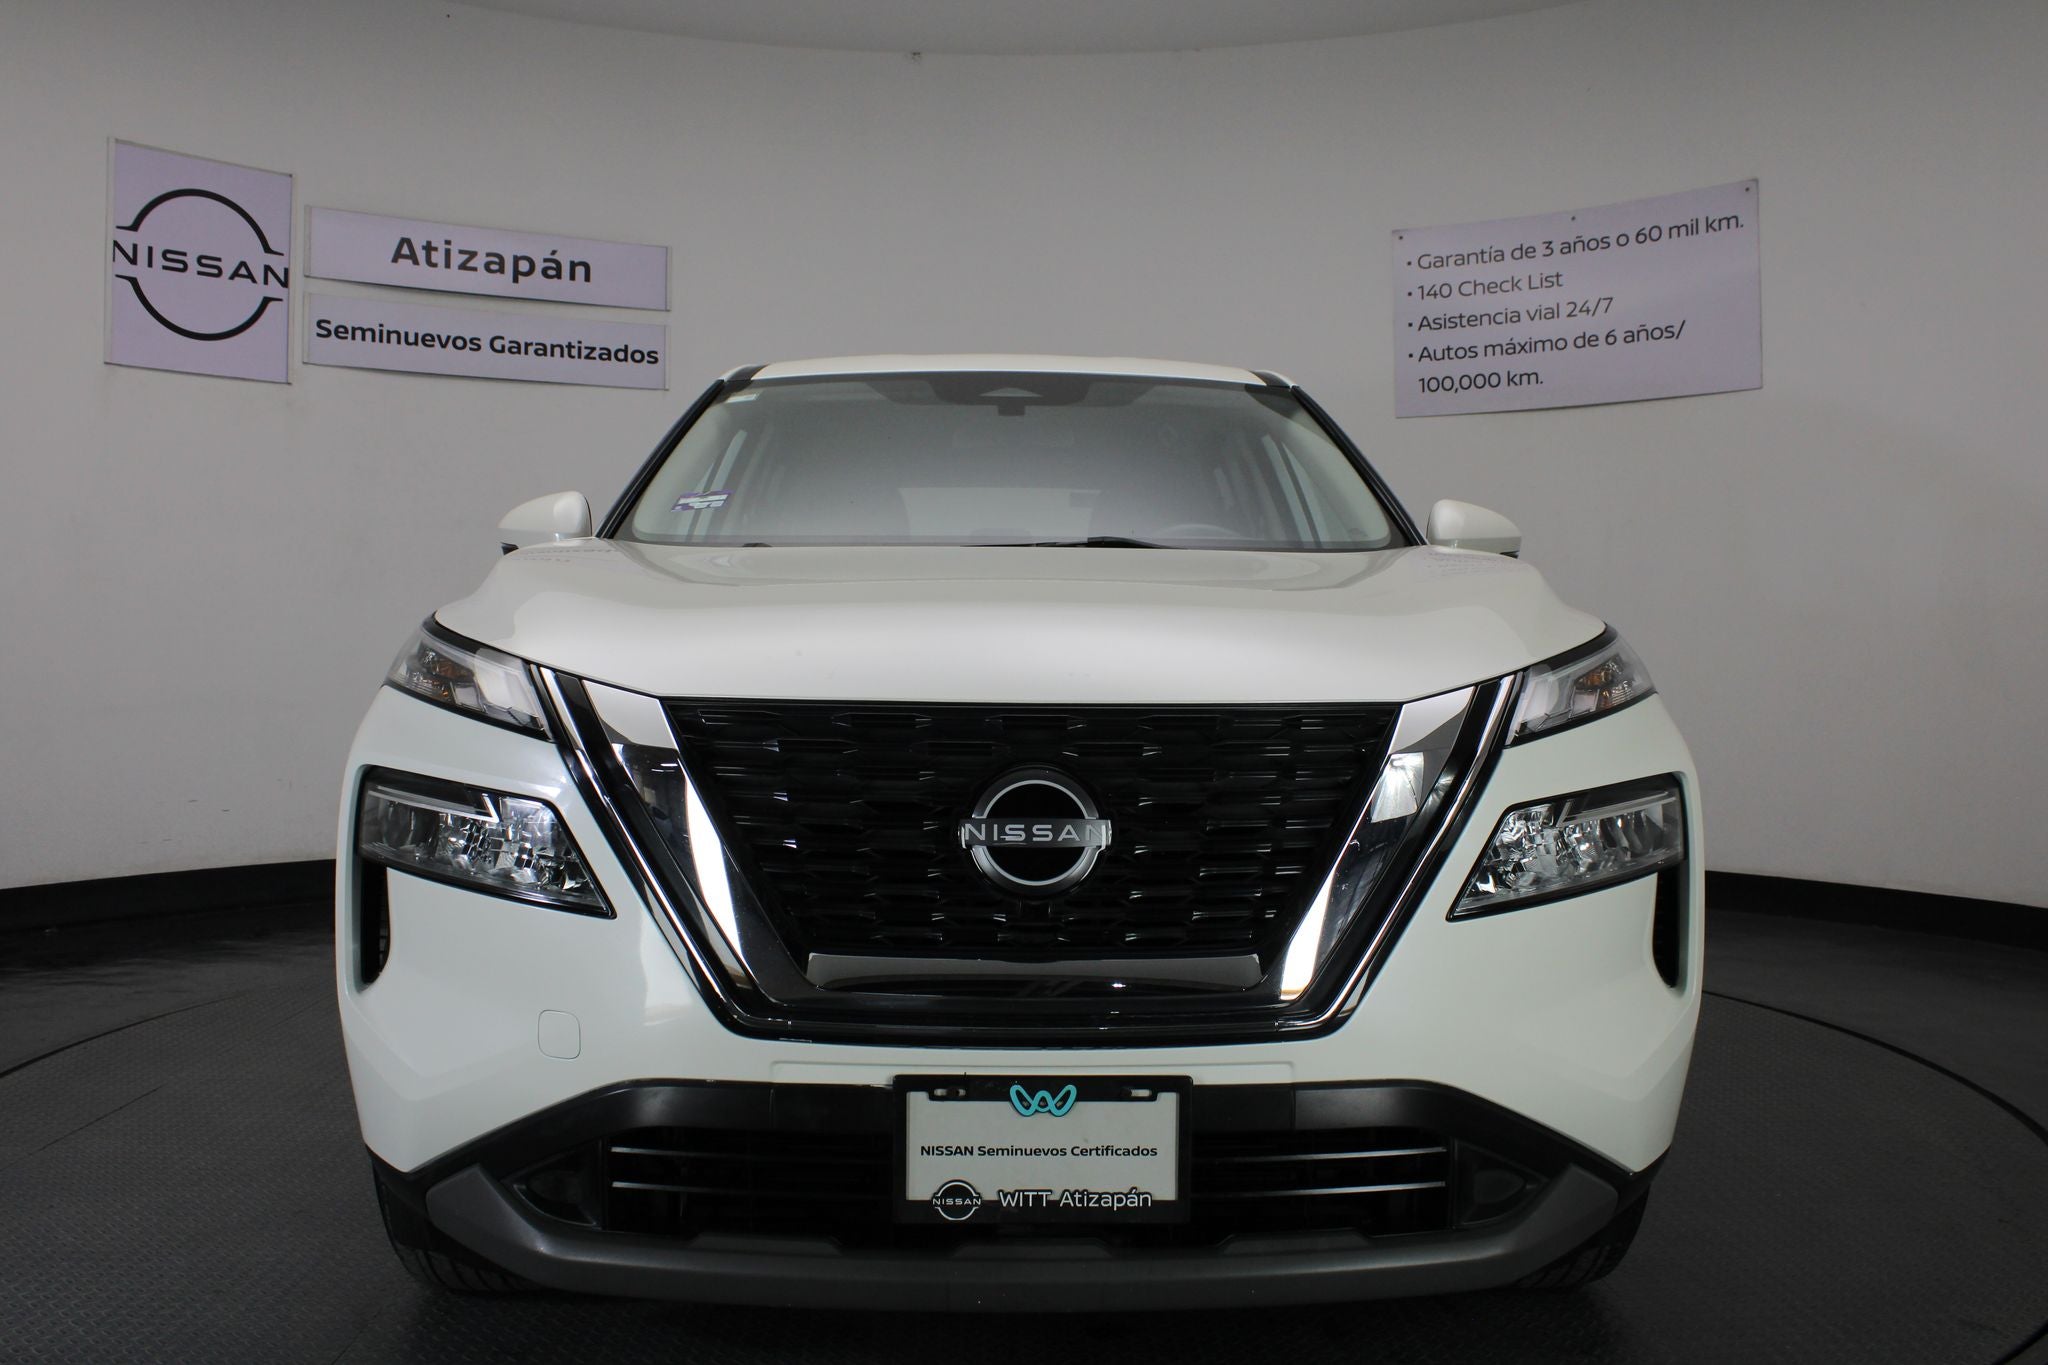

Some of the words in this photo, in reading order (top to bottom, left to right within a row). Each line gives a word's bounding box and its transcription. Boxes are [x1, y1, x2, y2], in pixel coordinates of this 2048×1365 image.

[1418, 245, 1505, 270] Garantía
[1511, 243, 1537, 260] de
[1542, 241, 1554, 256] 3
[1560, 236, 1611, 254] años
[1616, 234, 1630, 247] o
[1635, 225, 1662, 244] 60
[1669, 218, 1699, 239] mil
[1705, 213, 1744, 233] km.
[112, 240, 289, 289] NISSAN
[391, 237, 592, 283] Atizapán
[1418, 282, 1452, 300] 140
[1459, 277, 1522, 297] Check
[1529, 272, 1563, 289] List
[1418, 308, 1521, 331] Asistencia
[1526, 304, 1560, 320] vial
[1566, 297, 1613, 317] 24/7
[316, 319, 482, 353] Seminuevos
[489, 335, 659, 365] Garantizados
[1418, 344, 1478, 361] Autos
[1484, 337, 1568, 357] máximo
[1573, 332, 1599, 349] de
[1605, 330, 1617, 346] 6
[1623, 320, 1686, 343] años/
[1419, 372, 1501, 394] 100,000
[1507, 370, 1543, 387] km.
[964, 824, 1106, 842] NISSAN
[920, 1146, 974, 1157] NISSAN
[977, 1145, 1068, 1157] Seminuevos
[1070, 1145, 1158, 1157] Certificados
[932, 1197, 981, 1206] NISSAN
[999, 1190, 1052, 1207] WITT
[1060, 1188, 1151, 1211] Atizapán
